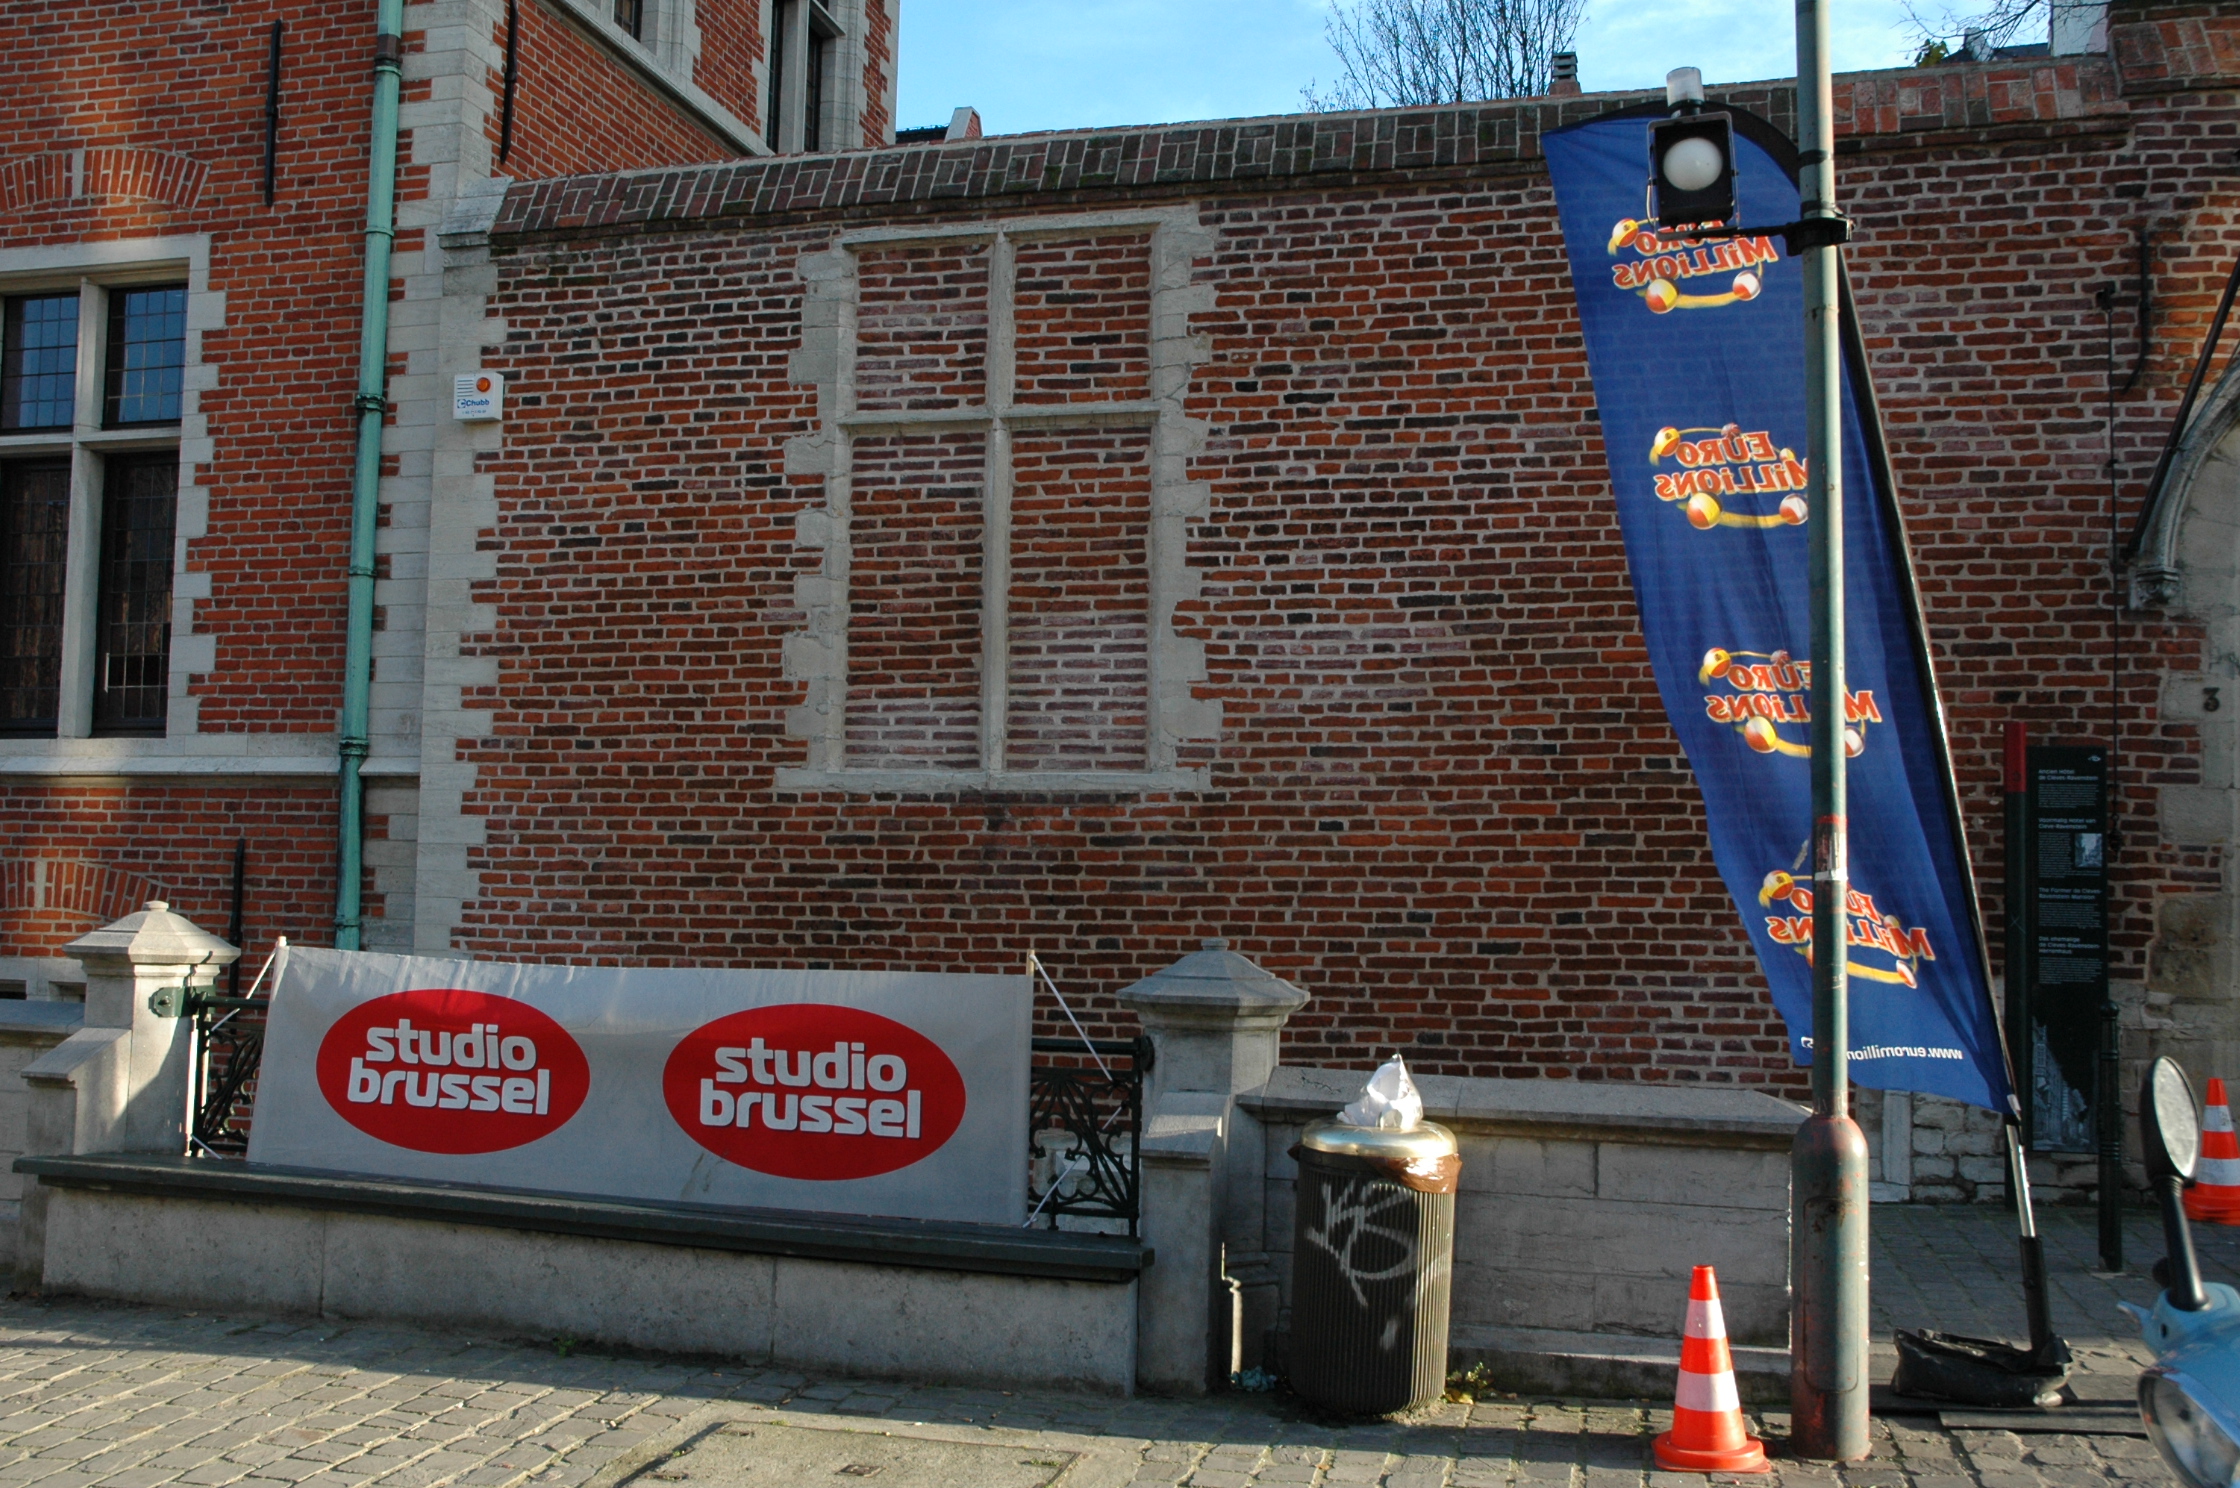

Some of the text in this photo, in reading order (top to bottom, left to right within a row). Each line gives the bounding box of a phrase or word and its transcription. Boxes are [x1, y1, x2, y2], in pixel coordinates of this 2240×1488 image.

[466, 399, 490, 407] Chubb
[366, 1018, 537, 1072] studio
[714, 1037, 907, 1093] studio
[347, 1057, 550, 1115] brussel
[699, 1078, 922, 1139] brussel
